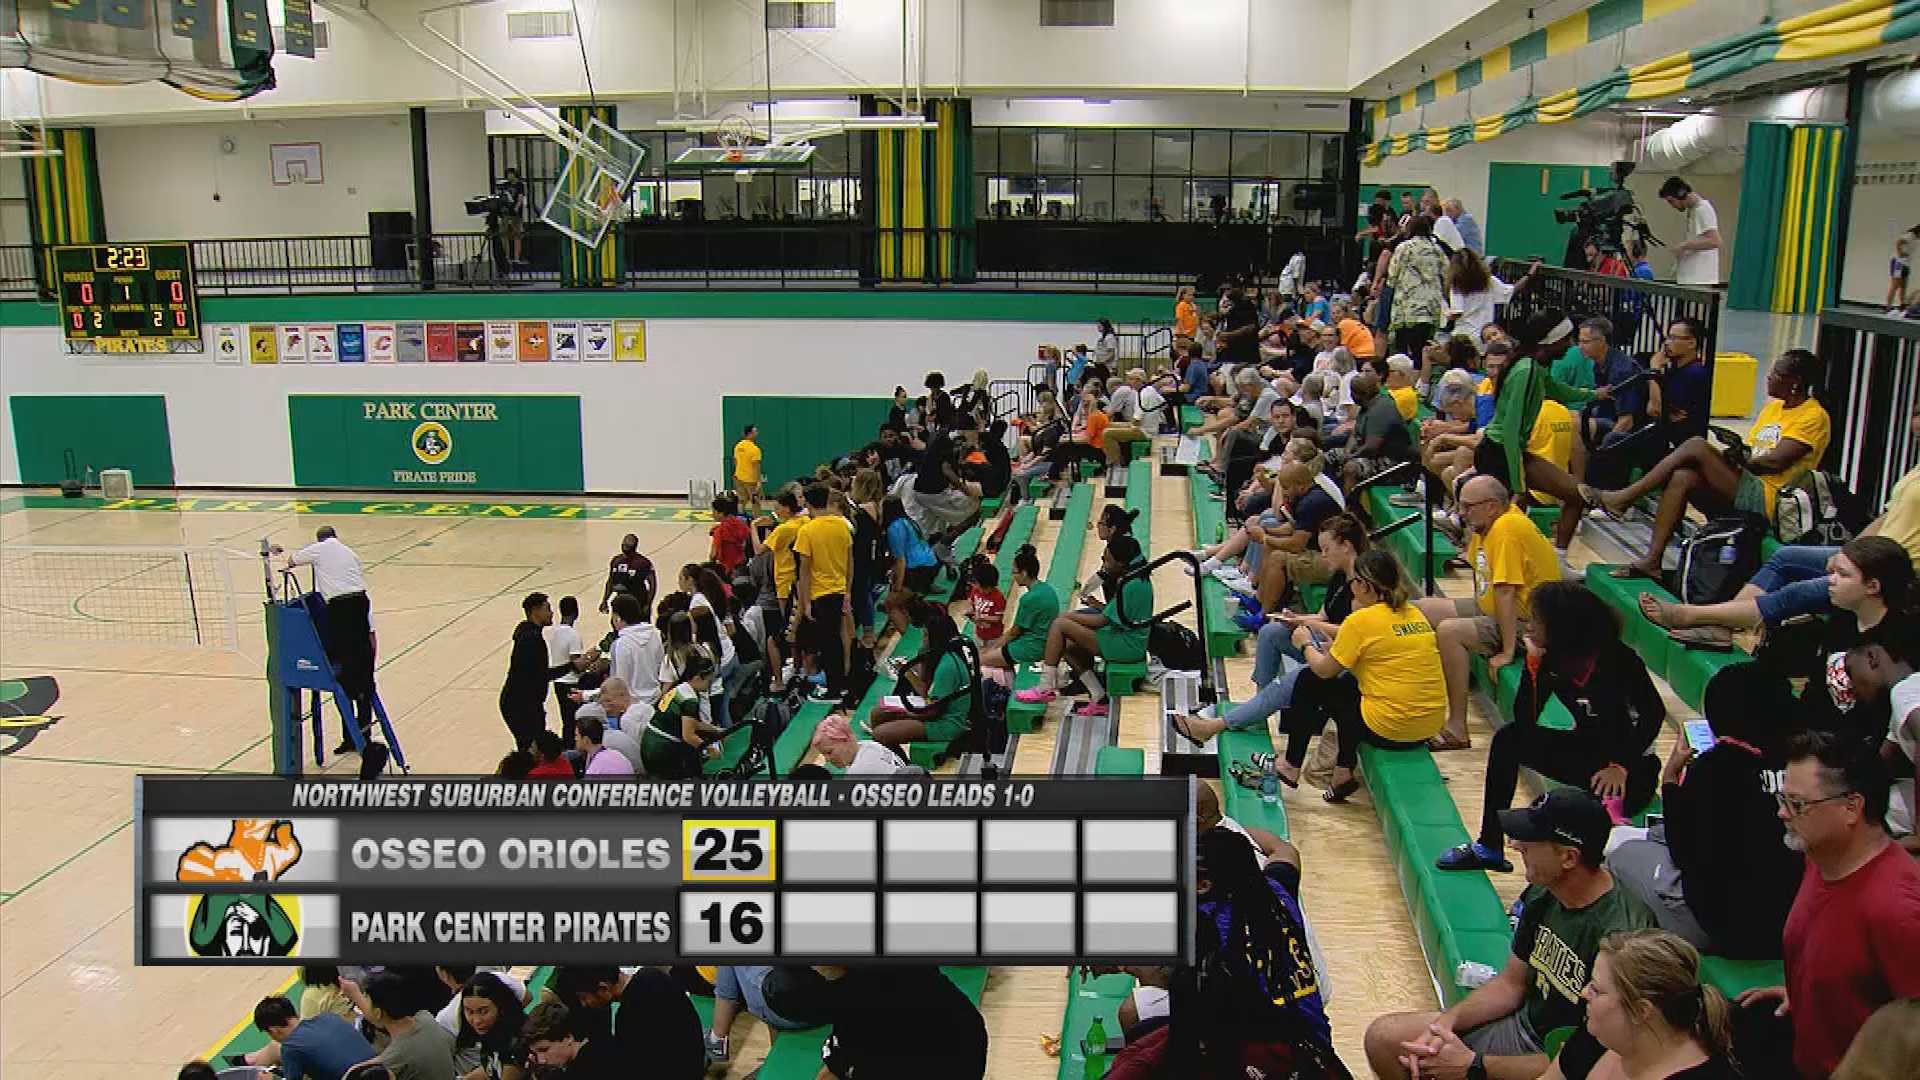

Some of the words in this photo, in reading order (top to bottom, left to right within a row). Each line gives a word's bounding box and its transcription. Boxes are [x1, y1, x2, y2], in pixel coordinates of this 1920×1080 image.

[107, 247, 146, 268] 2:23
[81, 283, 94, 305] 0
[170, 281, 183, 304] 0
[72, 311, 83, 329] 0
[93, 311, 103, 329] 2
[153, 311, 163, 327] 2
[175, 311, 186, 329] 0
[95, 338, 168, 353] PIRATES
[363, 401, 417, 420] PARK
[420, 402, 498, 420] CENTER
[393, 470, 438, 483] PIRATE
[439, 471, 477, 483] PRIDE
[101, 498, 330, 512] PARK
[361, 502, 716, 519] CENTER
